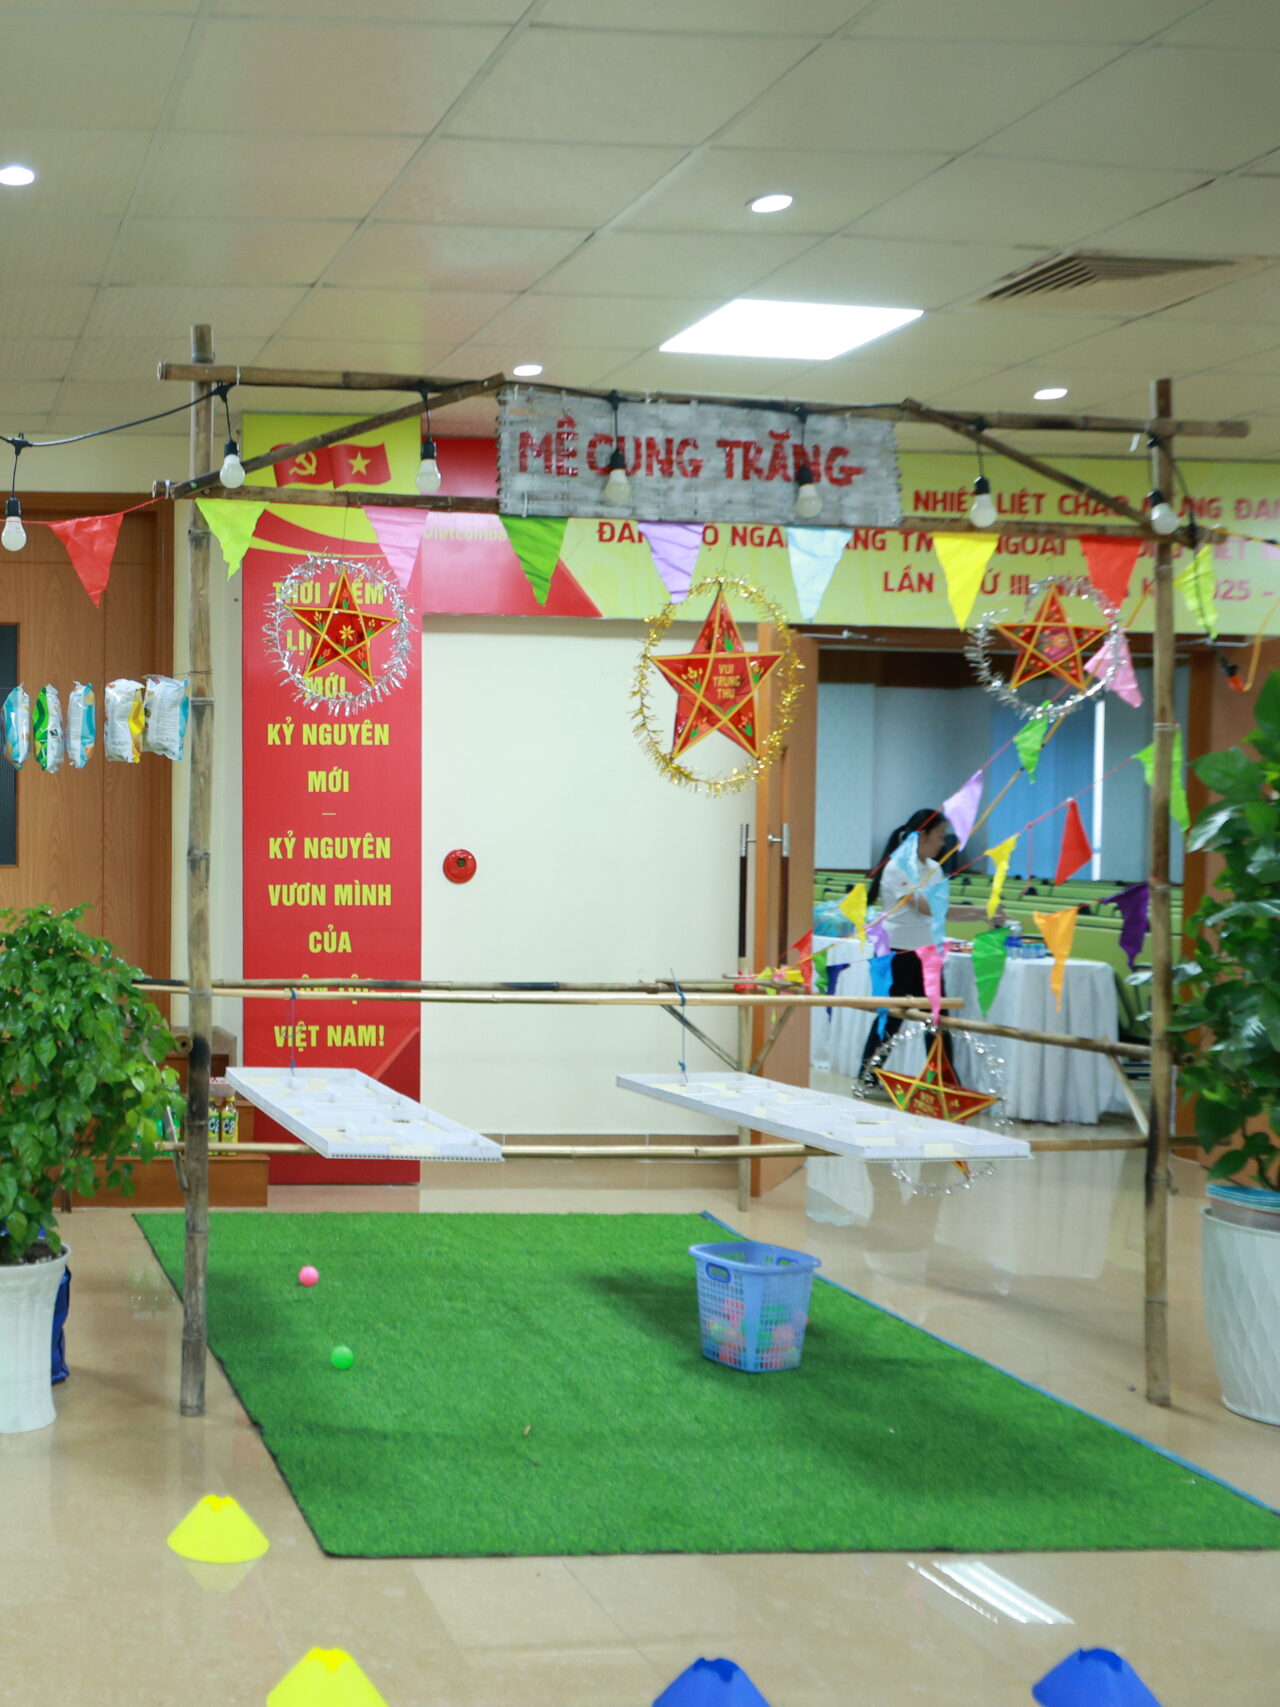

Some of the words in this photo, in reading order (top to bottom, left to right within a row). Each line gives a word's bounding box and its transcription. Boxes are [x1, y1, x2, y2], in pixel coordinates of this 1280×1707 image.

[519, 416, 578, 477] MÊ
[586, 434, 704, 478] CUNG
[717, 429, 866, 486] TRĂNG
[423, 527, 509, 541] Vietcomba
[267, 716, 295, 745] KỶ
[302, 719, 390, 745] NGUYÊN
[308, 766, 349, 792] MỚI
[269, 830, 296, 859] KỶ
[304, 833, 391, 859] NGUYÊN
[268, 882, 326, 906] VƯƠN
[334, 880, 392, 906] MÌNH
[308, 924, 352, 953] CỦA
[274, 1020, 319, 1052] VIỆT
[327, 1025, 385, 1047] NAM!
